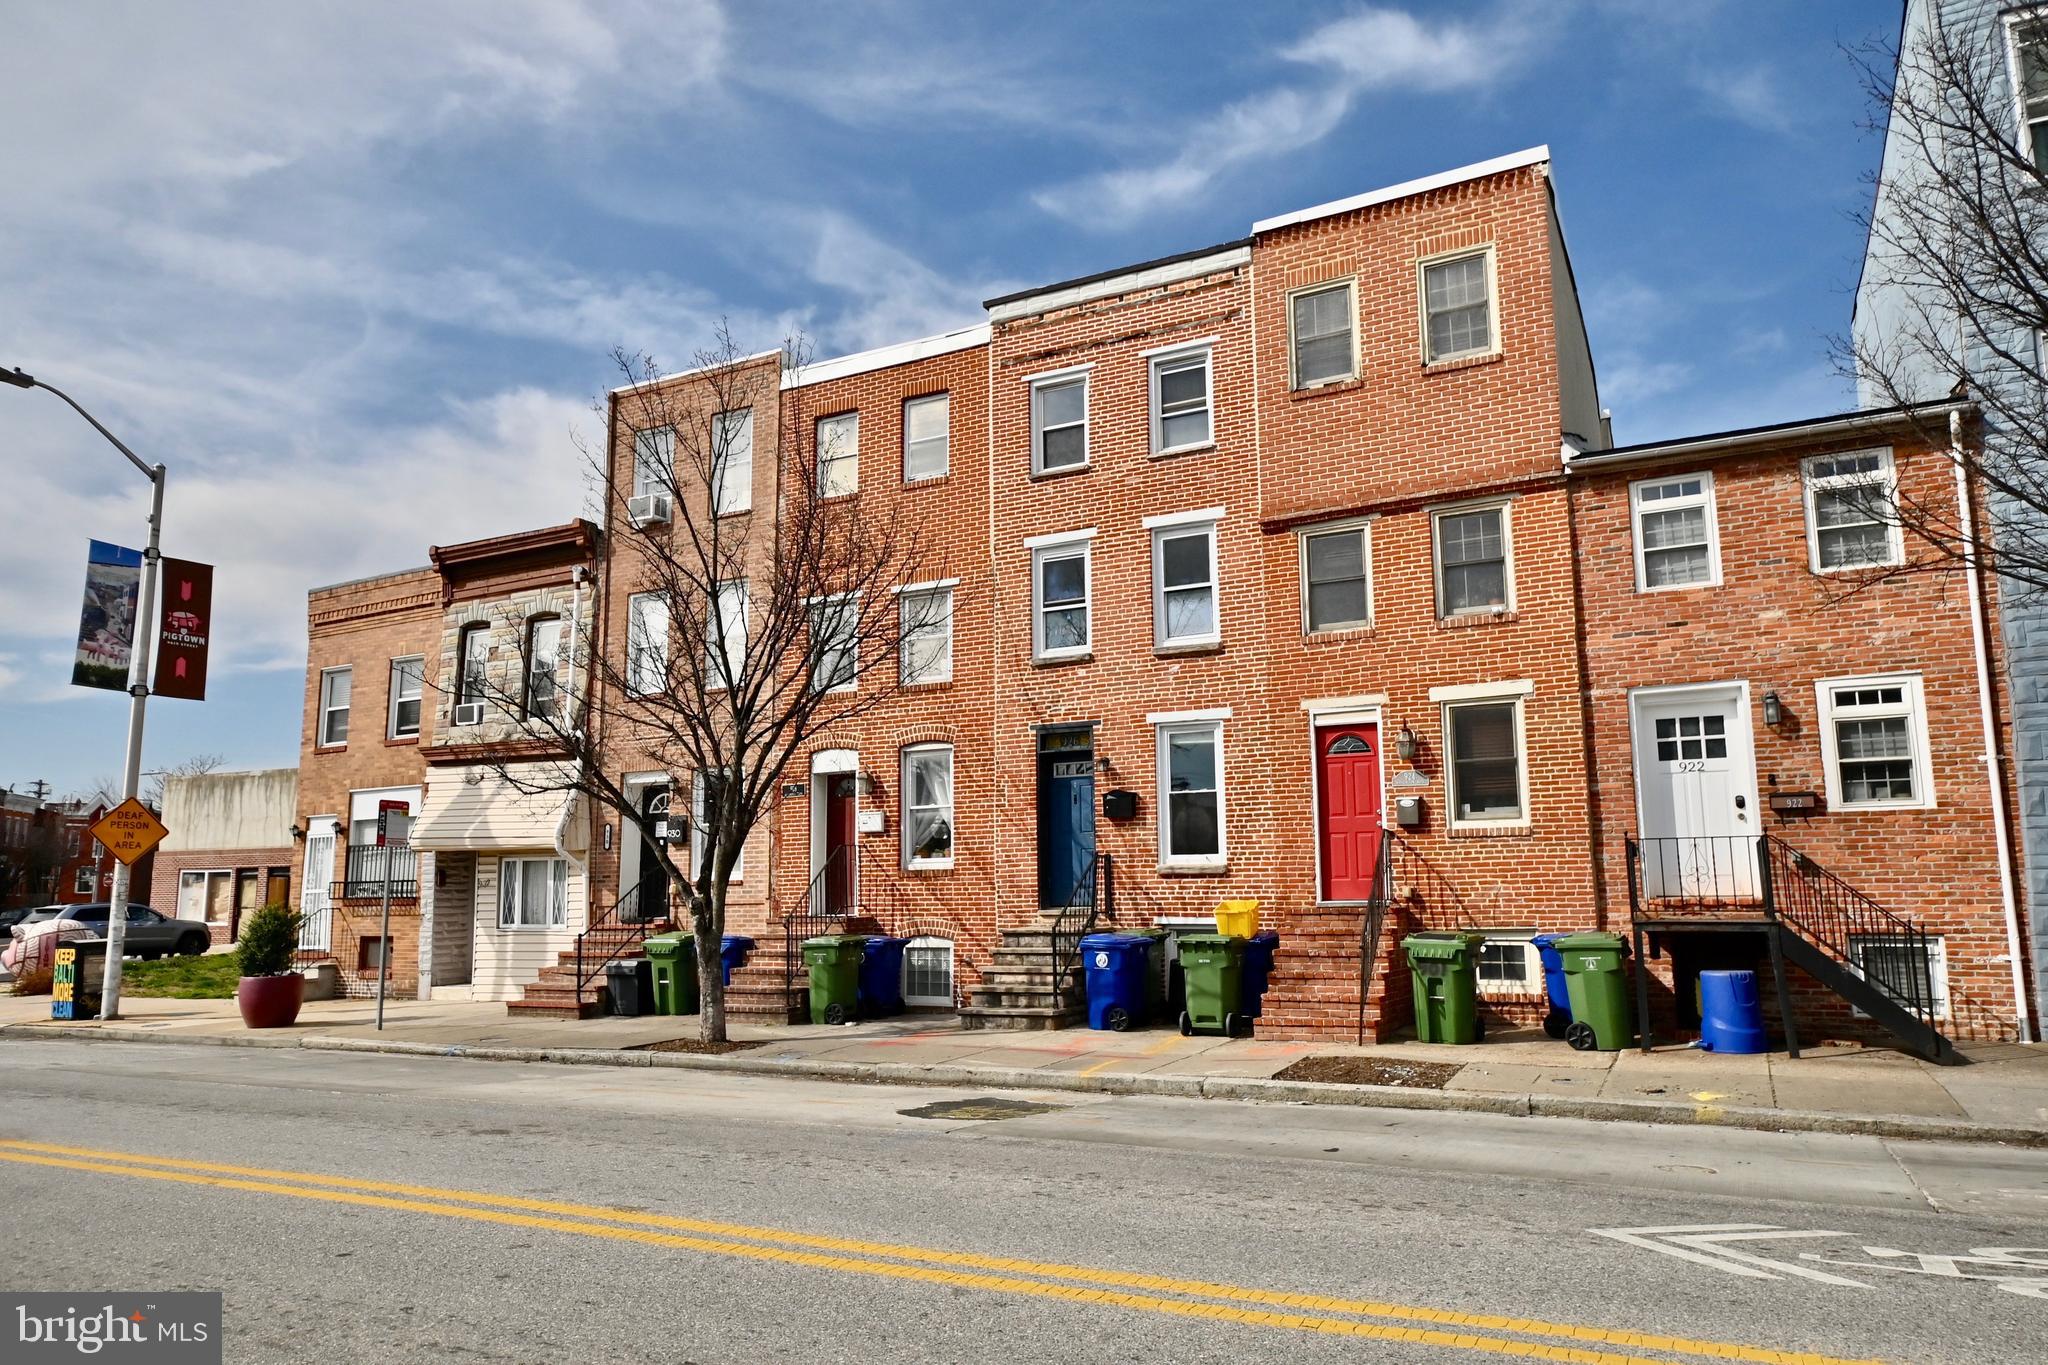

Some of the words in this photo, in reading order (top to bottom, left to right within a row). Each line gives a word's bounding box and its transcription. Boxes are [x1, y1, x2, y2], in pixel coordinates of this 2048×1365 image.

[162, 631, 206, 645] PIGTOWN
[1679, 761, 1705, 772] 922
[1786, 799, 1803, 808] 922
[117, 811, 144, 820] DEAF
[110, 821, 150, 830] PERSON
[123, 831, 134, 840] IN
[667, 829, 681, 838] 930
[114, 841, 142, 850] AREA
[55, 949, 75, 965] KEEP
[54, 964, 75, 983] BALTI
[52, 983, 74, 1002] MORE
[51, 1001, 73, 1018] CLEAN
